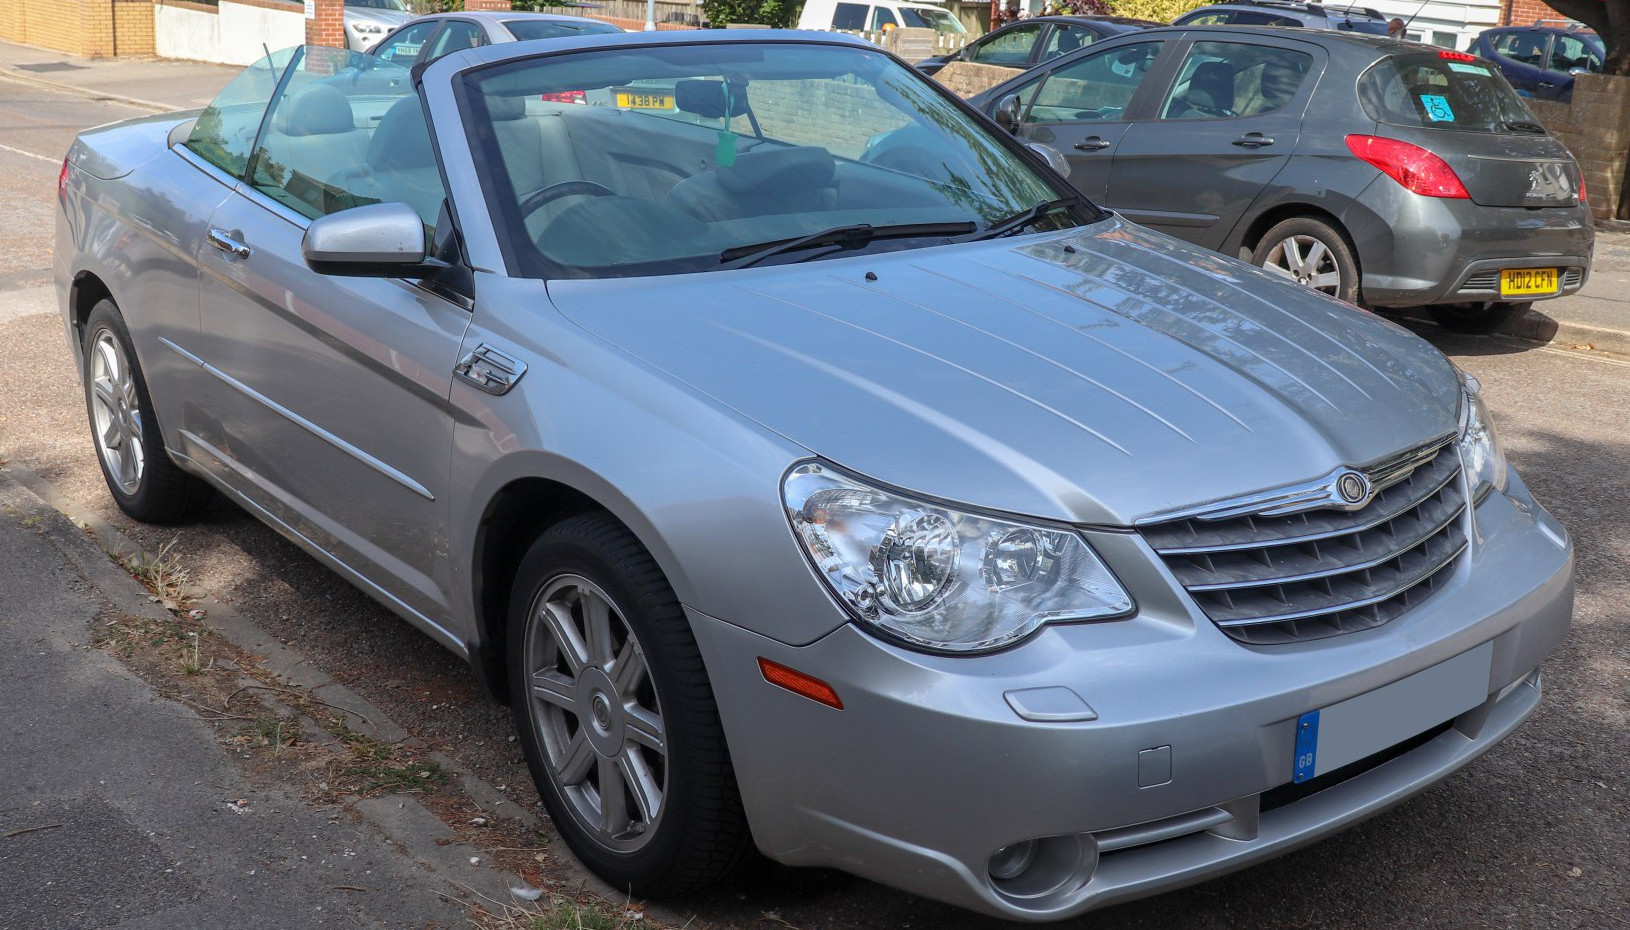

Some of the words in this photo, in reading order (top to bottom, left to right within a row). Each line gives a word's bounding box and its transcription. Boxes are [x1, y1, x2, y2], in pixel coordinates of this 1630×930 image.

[1508, 271, 1532, 290] HD12
[1534, 270, 1553, 289] CFN
[1299, 752, 1313, 769] GB
